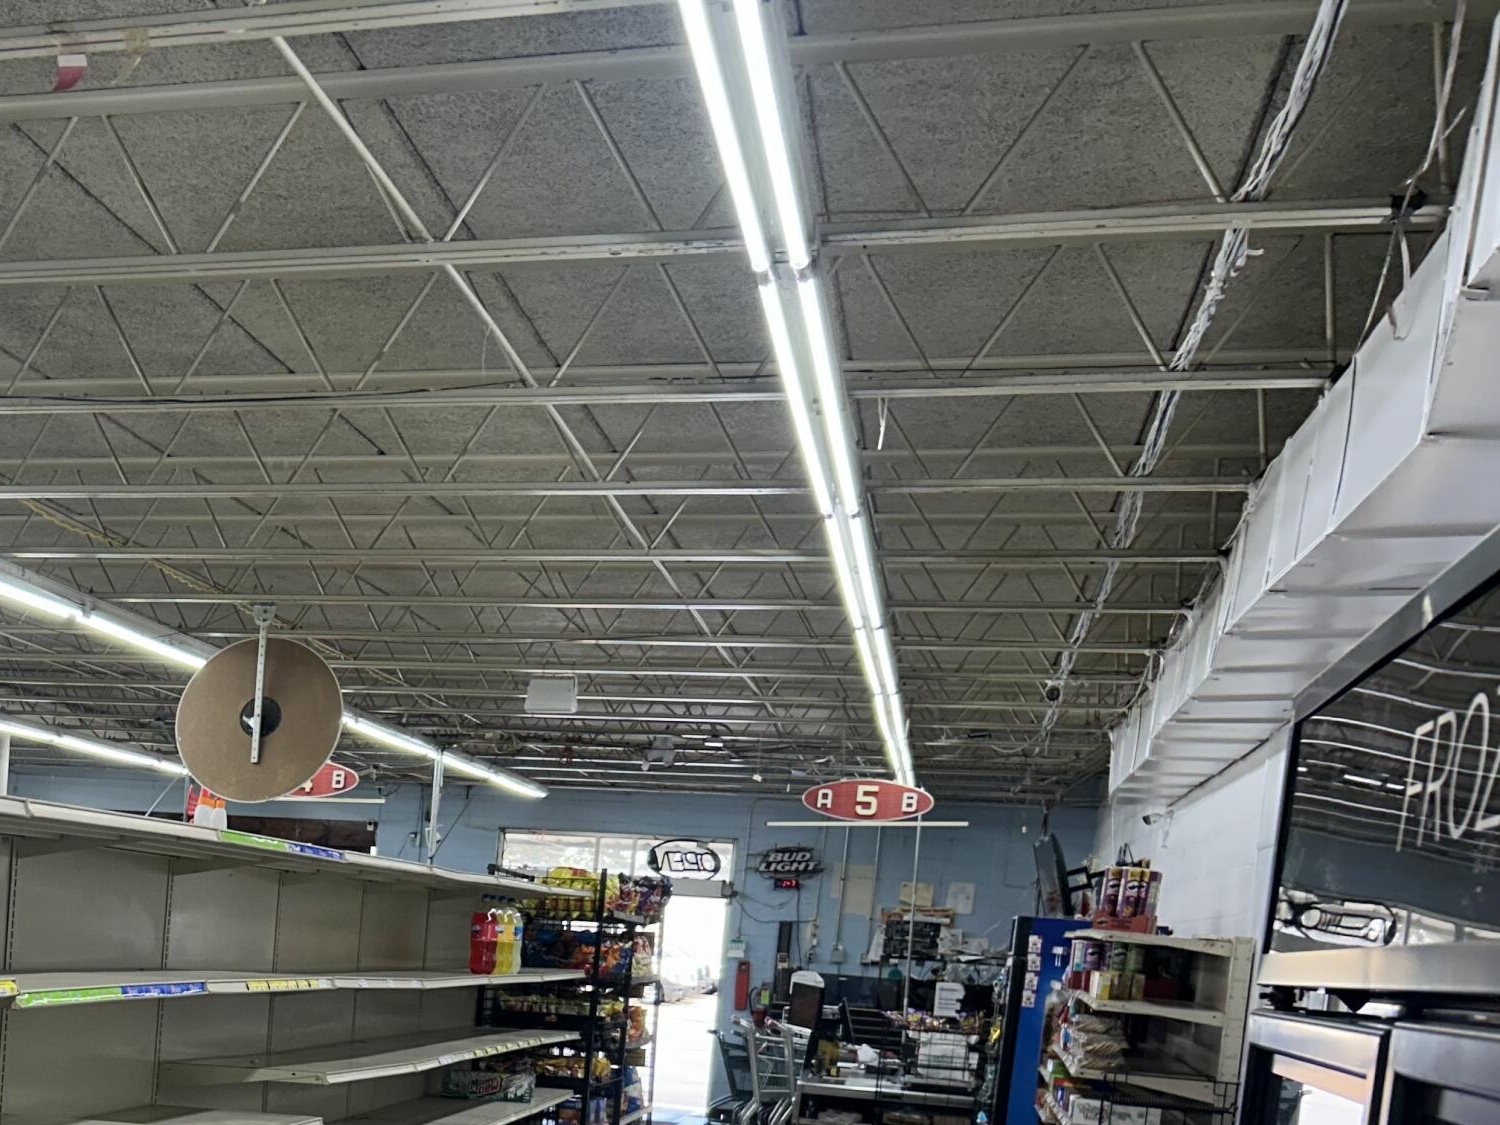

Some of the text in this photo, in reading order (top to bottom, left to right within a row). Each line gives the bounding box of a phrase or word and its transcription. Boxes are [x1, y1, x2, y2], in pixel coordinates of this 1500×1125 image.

[331, 769, 344, 788] B
[817, 785, 917, 816] A 5 B
[768, 852, 813, 862] BUD
[759, 861, 820, 872] LIGHT
